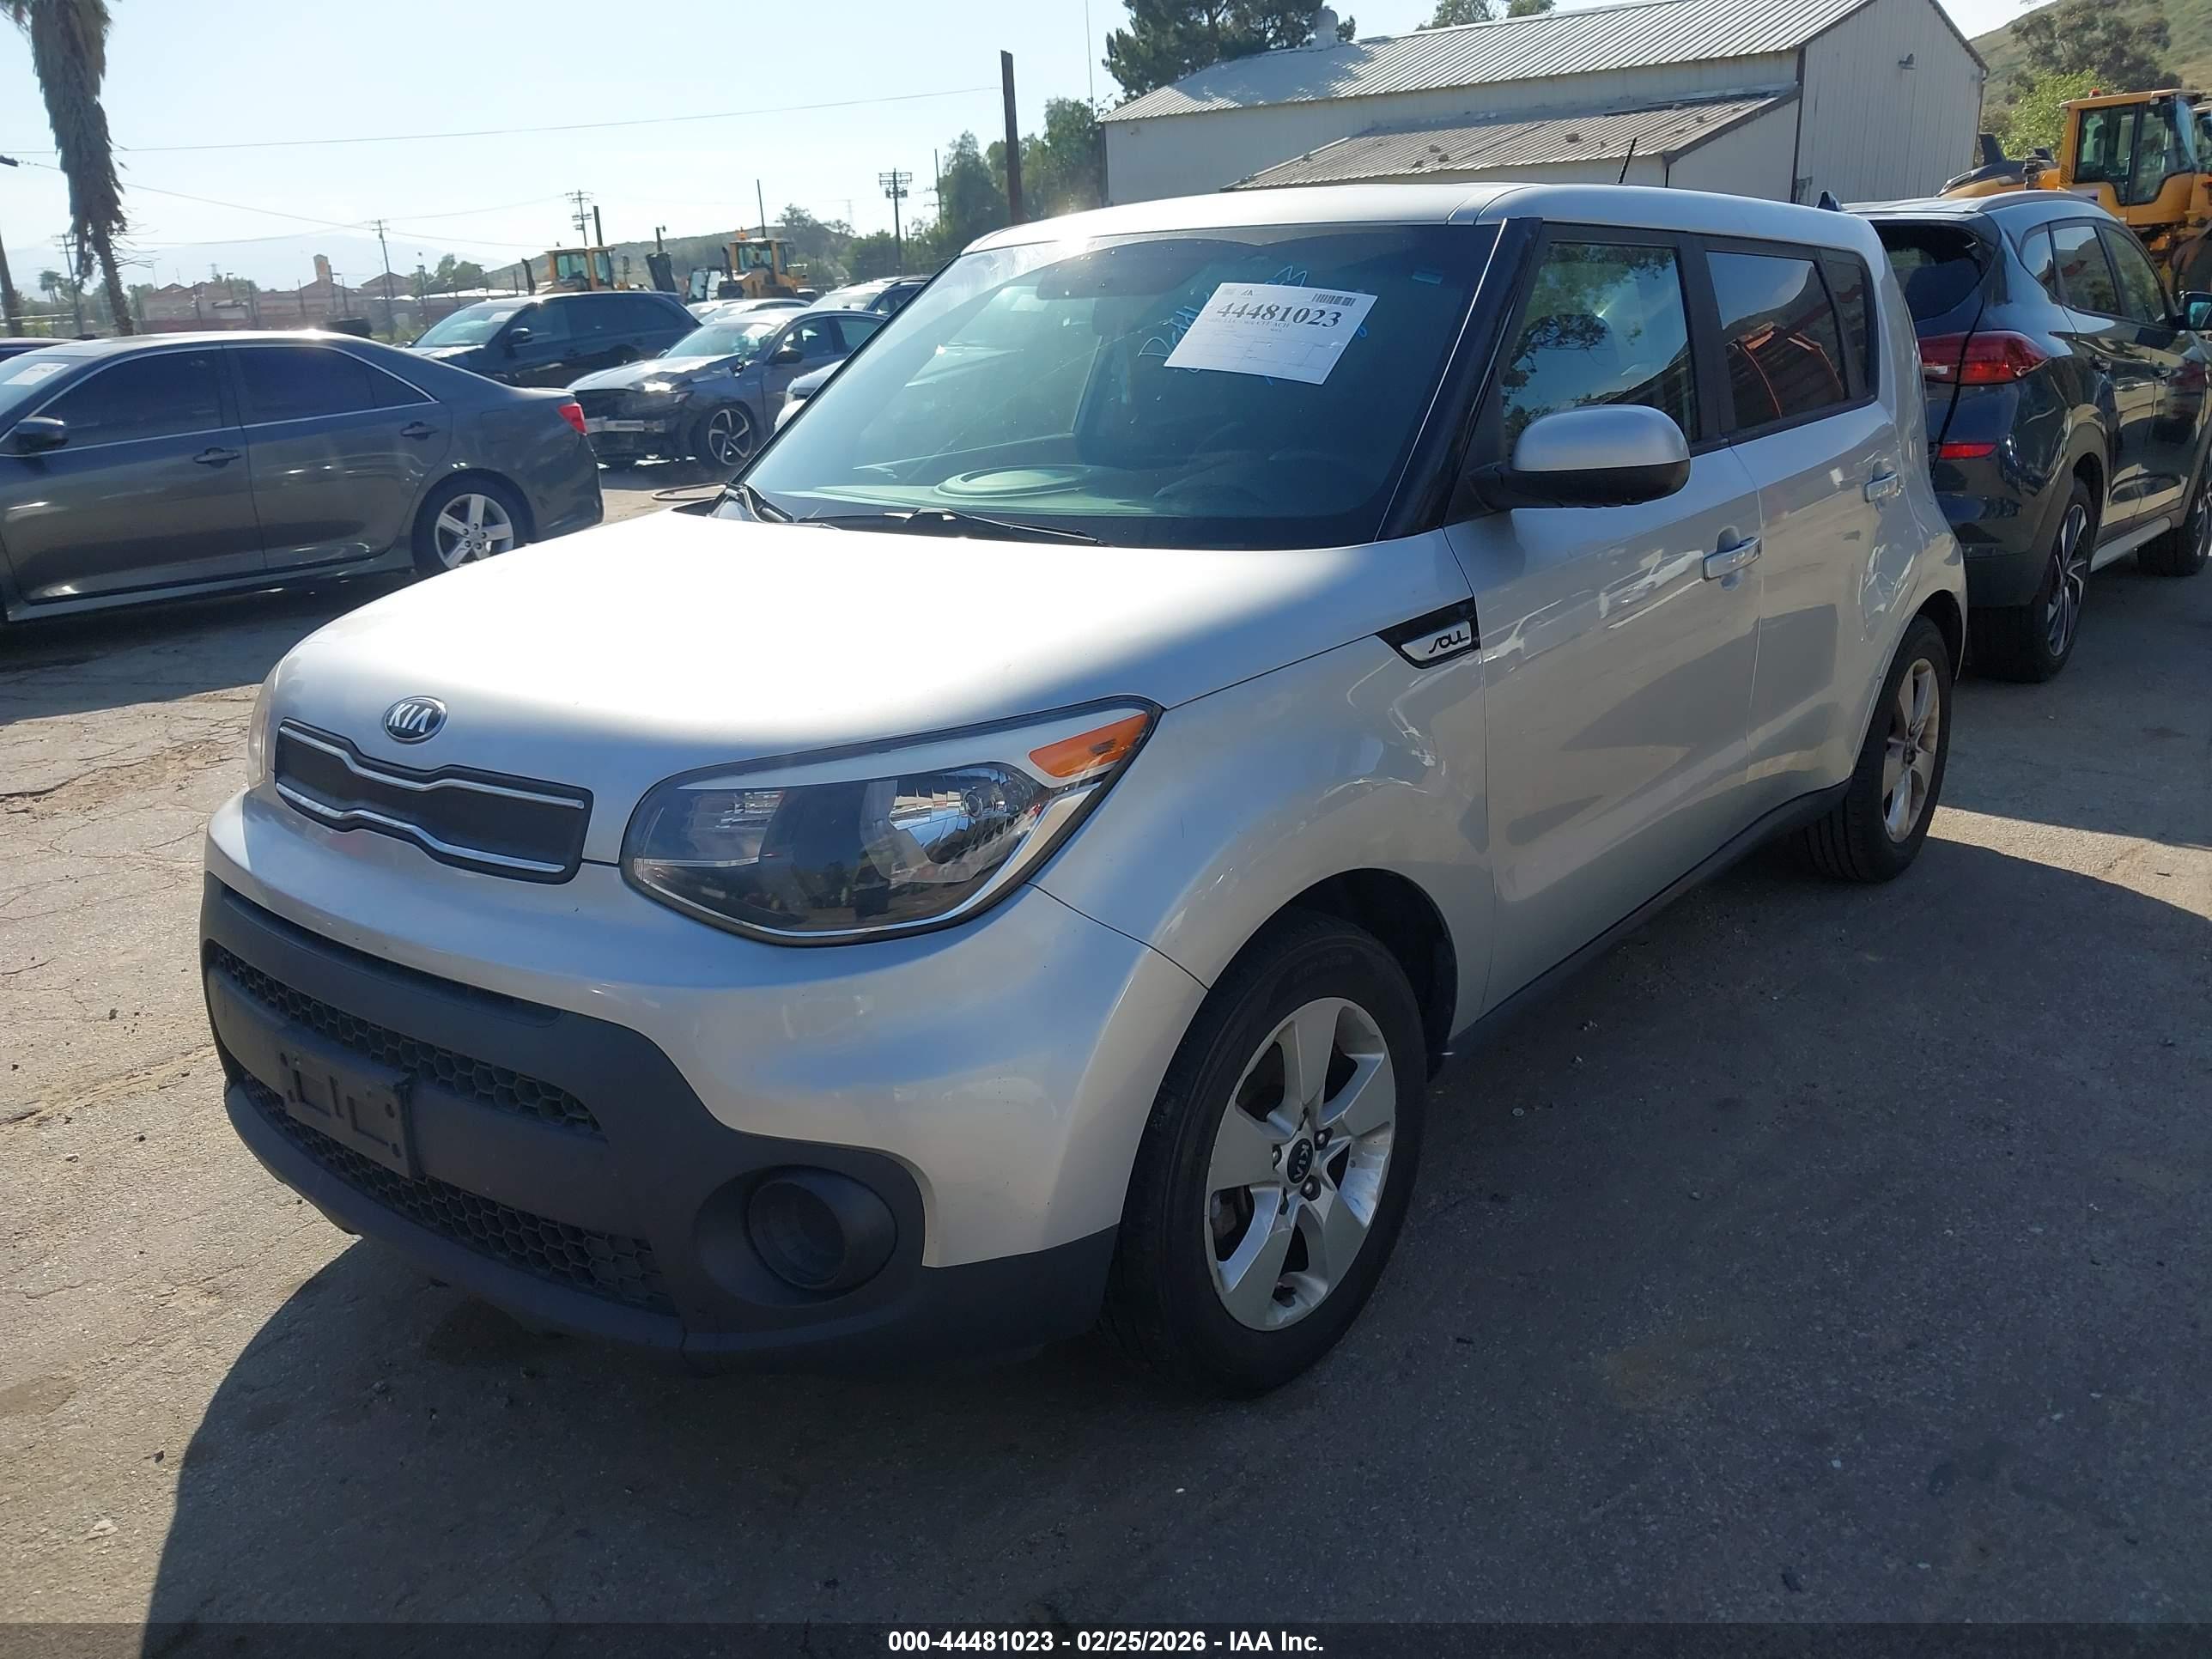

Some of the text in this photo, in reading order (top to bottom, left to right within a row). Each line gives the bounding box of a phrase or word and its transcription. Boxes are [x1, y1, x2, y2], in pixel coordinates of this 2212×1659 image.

[1217, 301, 1342, 328] 44481023
[387, 702, 434, 733] KIA
[1293, 1144, 1310, 1179] KIA
